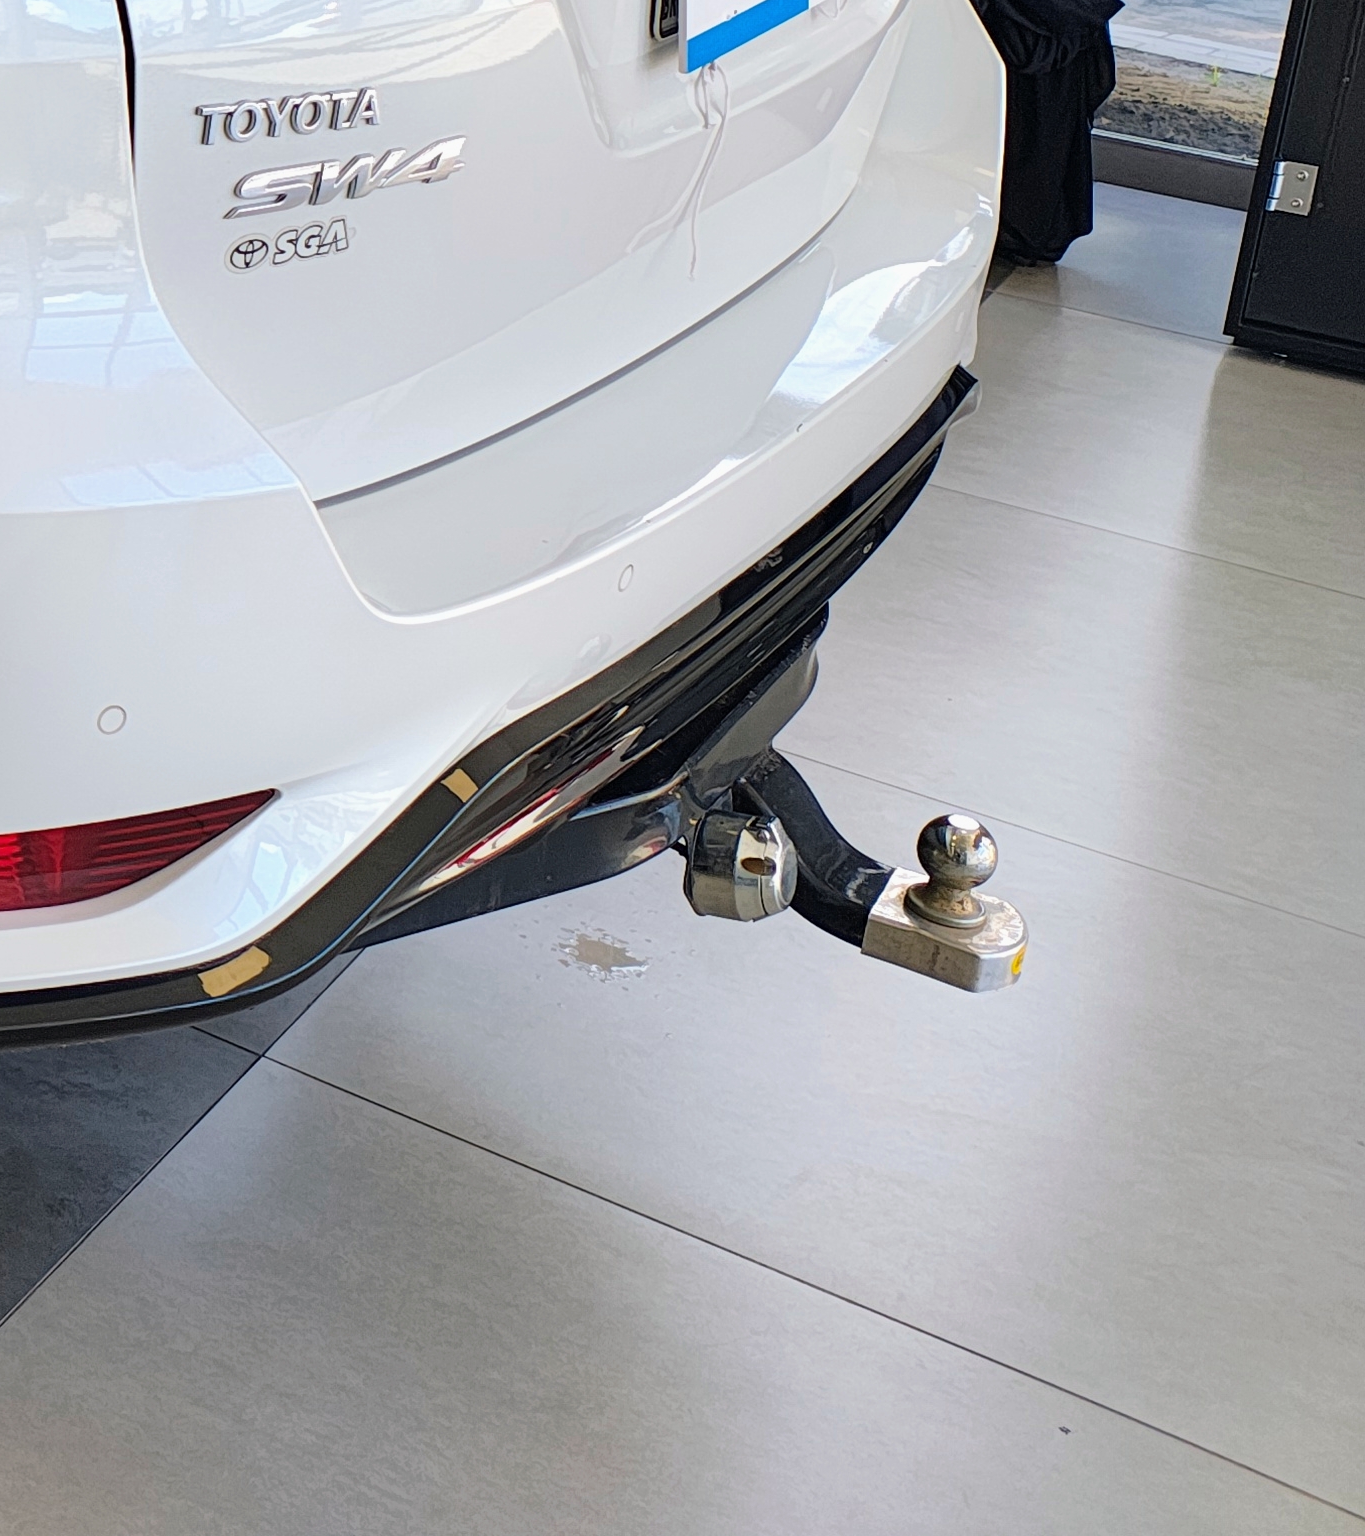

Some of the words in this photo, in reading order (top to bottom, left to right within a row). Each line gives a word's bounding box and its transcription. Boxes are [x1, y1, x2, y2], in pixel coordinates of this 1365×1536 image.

[195, 86, 380, 146] TOYOTA
[223, 134, 467, 219] SW4
[272, 217, 350, 265] SGA
